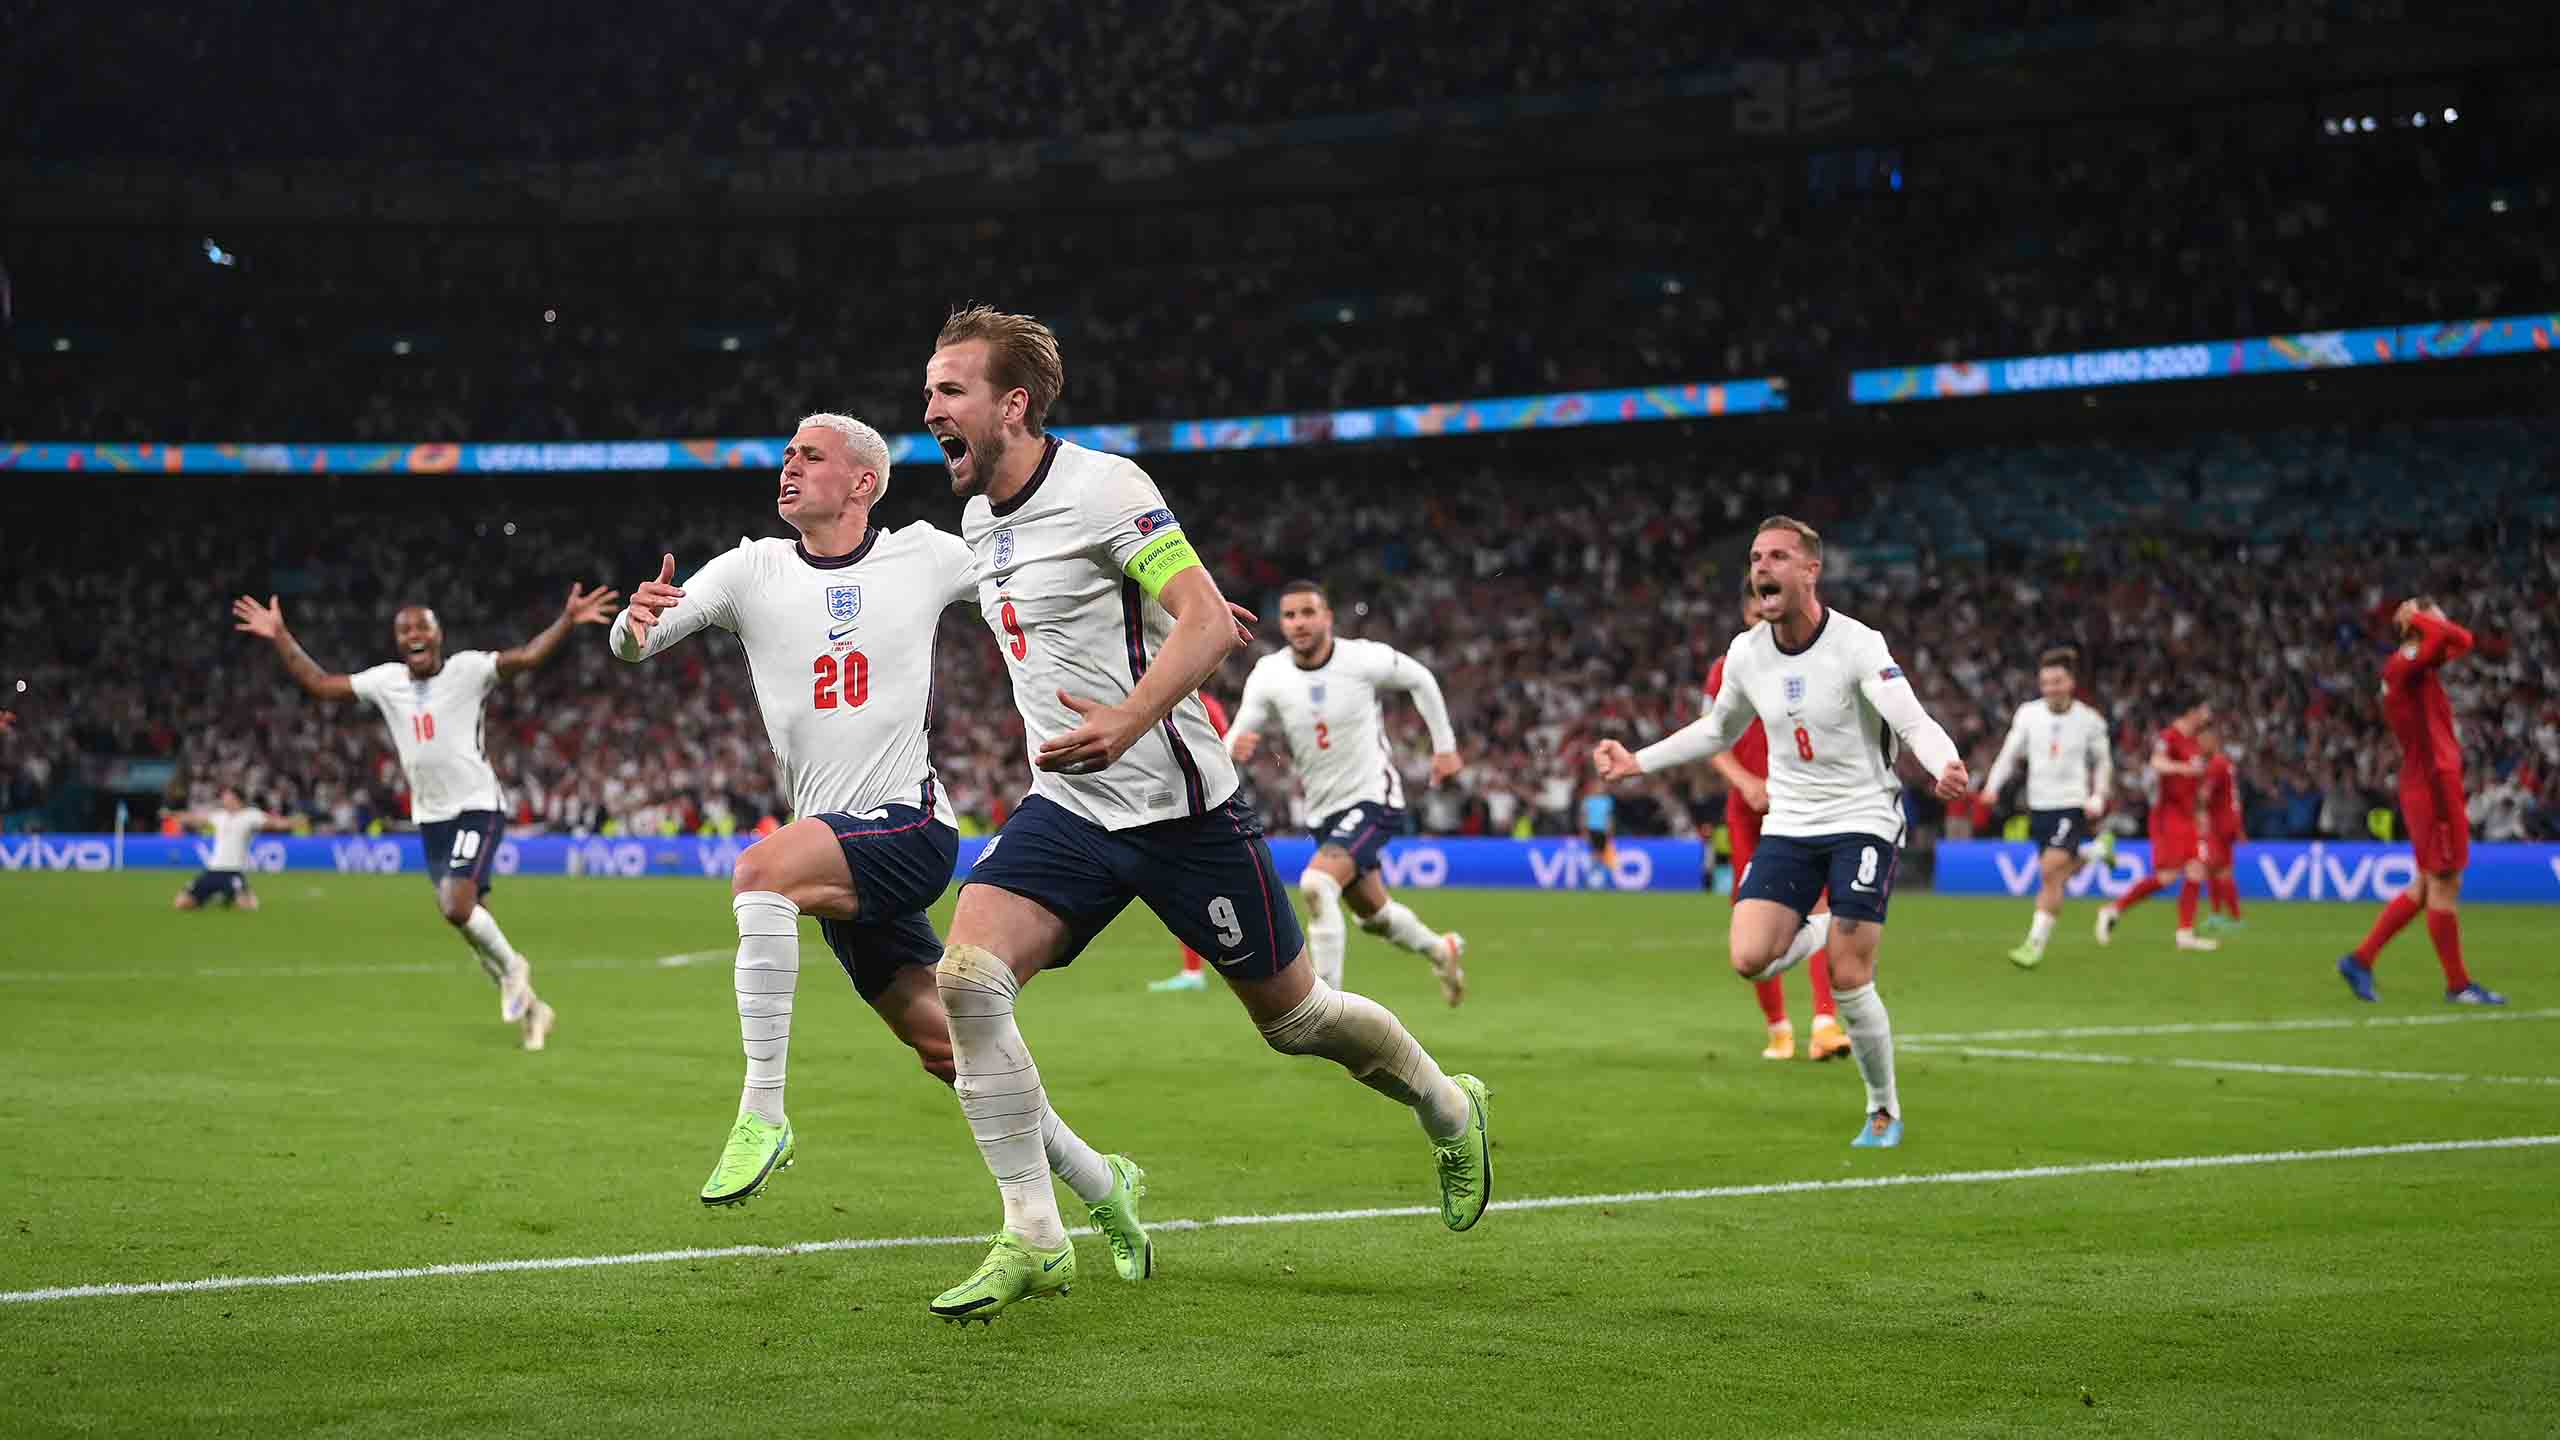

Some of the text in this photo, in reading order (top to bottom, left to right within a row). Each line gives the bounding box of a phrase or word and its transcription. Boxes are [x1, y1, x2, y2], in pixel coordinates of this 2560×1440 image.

[2005, 344, 2209, 390] UEFA EURO 2020
[1001, 601, 1027, 662] 9
[813, 650, 869, 709] 20
[411, 713, 435, 743] 10
[1315, 722, 1329, 749] 2
[1794, 727, 1813, 762] 8
[0, 834, 111, 871] vivo
[331, 837, 401, 875] vivo
[452, 829, 480, 859] 10
[1857, 846, 1879, 885] 8
[2259, 840, 2418, 900] vivo
[1207, 896, 1244, 948] 9
